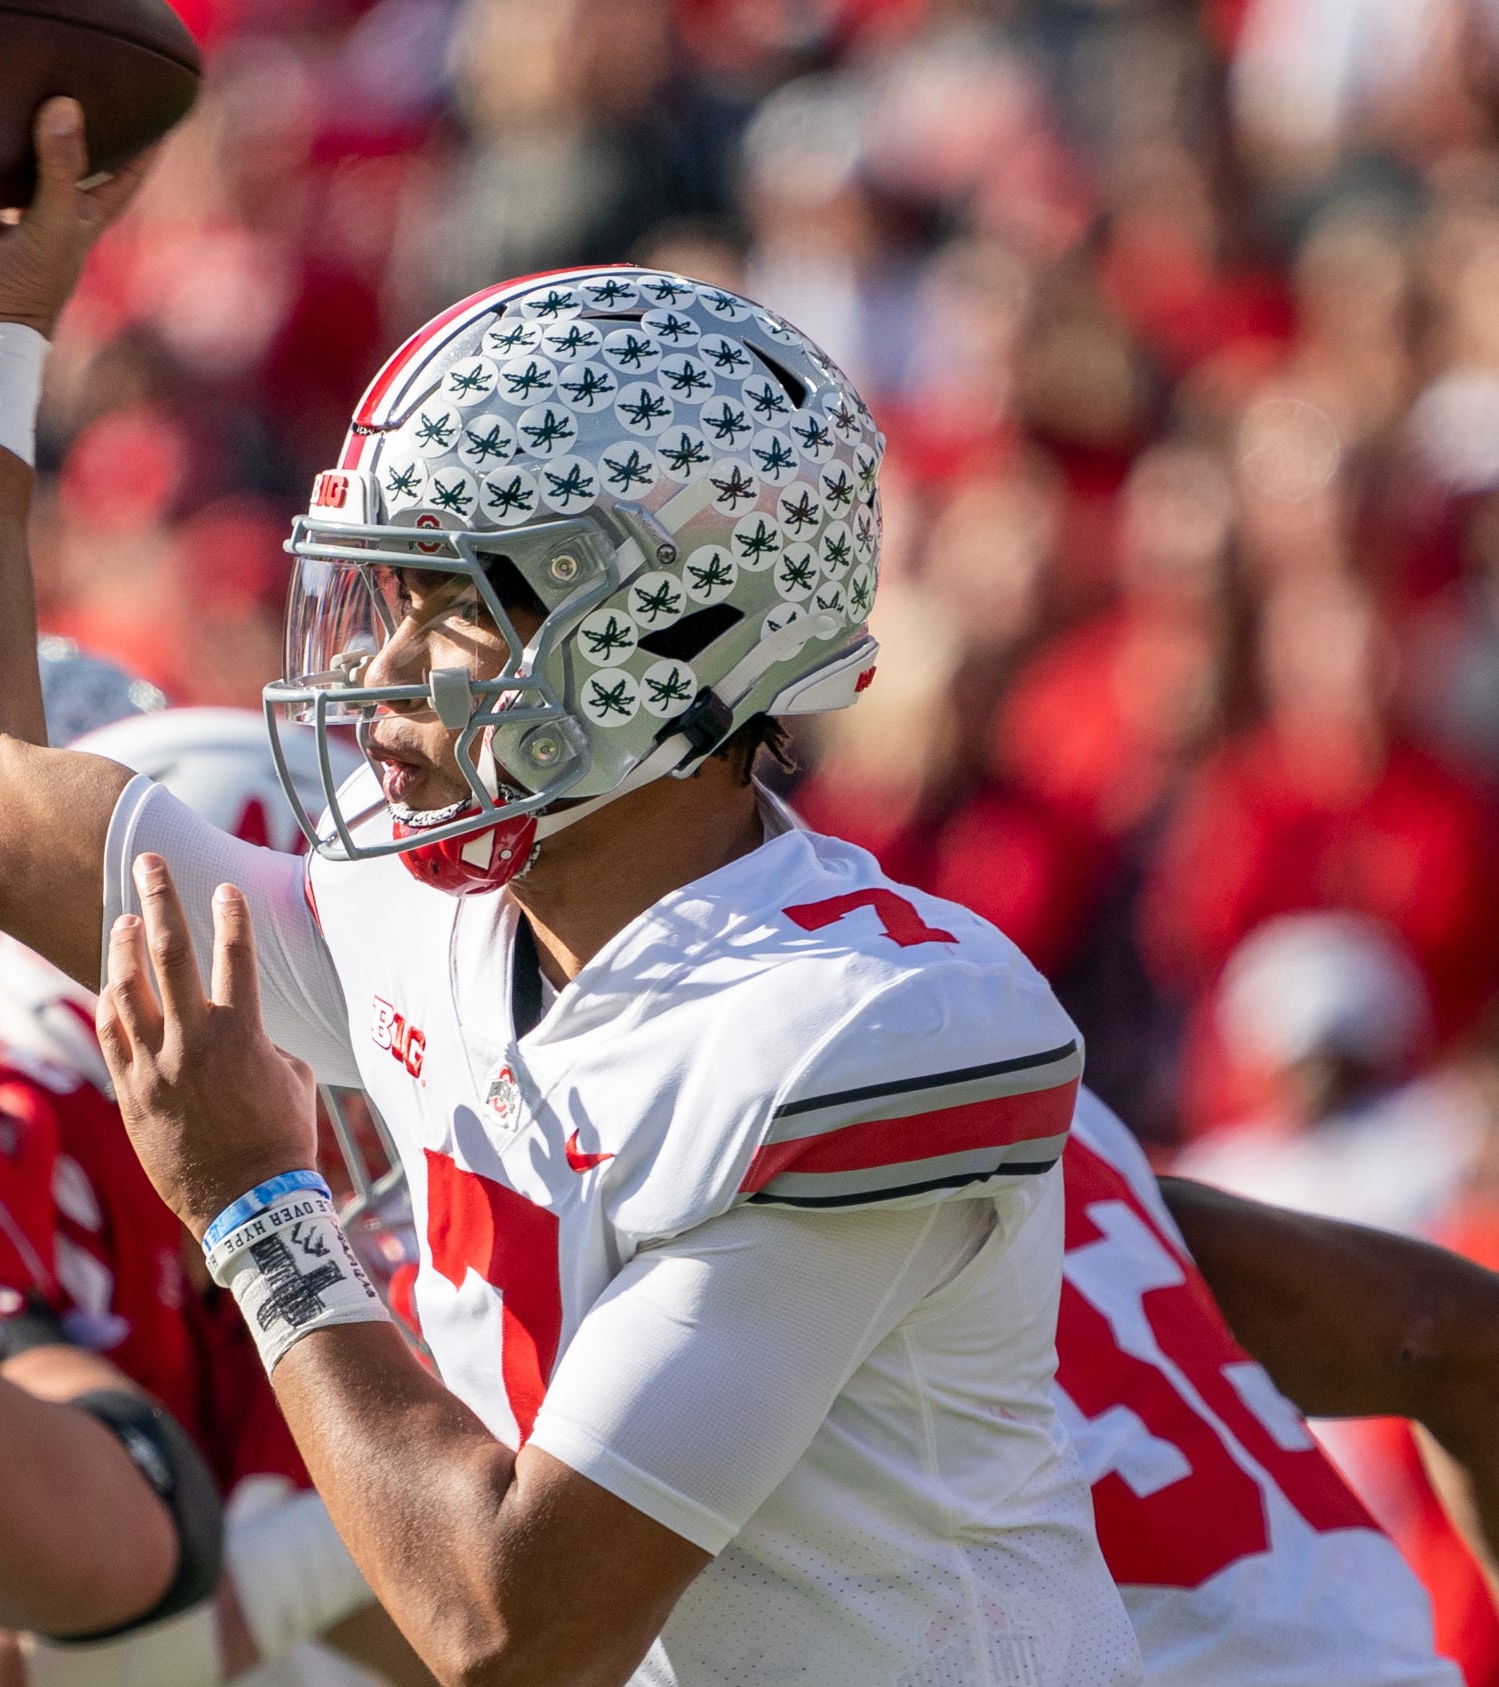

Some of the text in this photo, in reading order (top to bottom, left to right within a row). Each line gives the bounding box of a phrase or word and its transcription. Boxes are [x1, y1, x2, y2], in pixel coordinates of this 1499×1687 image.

[781, 888, 960, 948] 7
[223, 1219, 268, 1255] HYPE
[269, 1201, 314, 1227] OVER
[422, 1146, 563, 1450] 7
